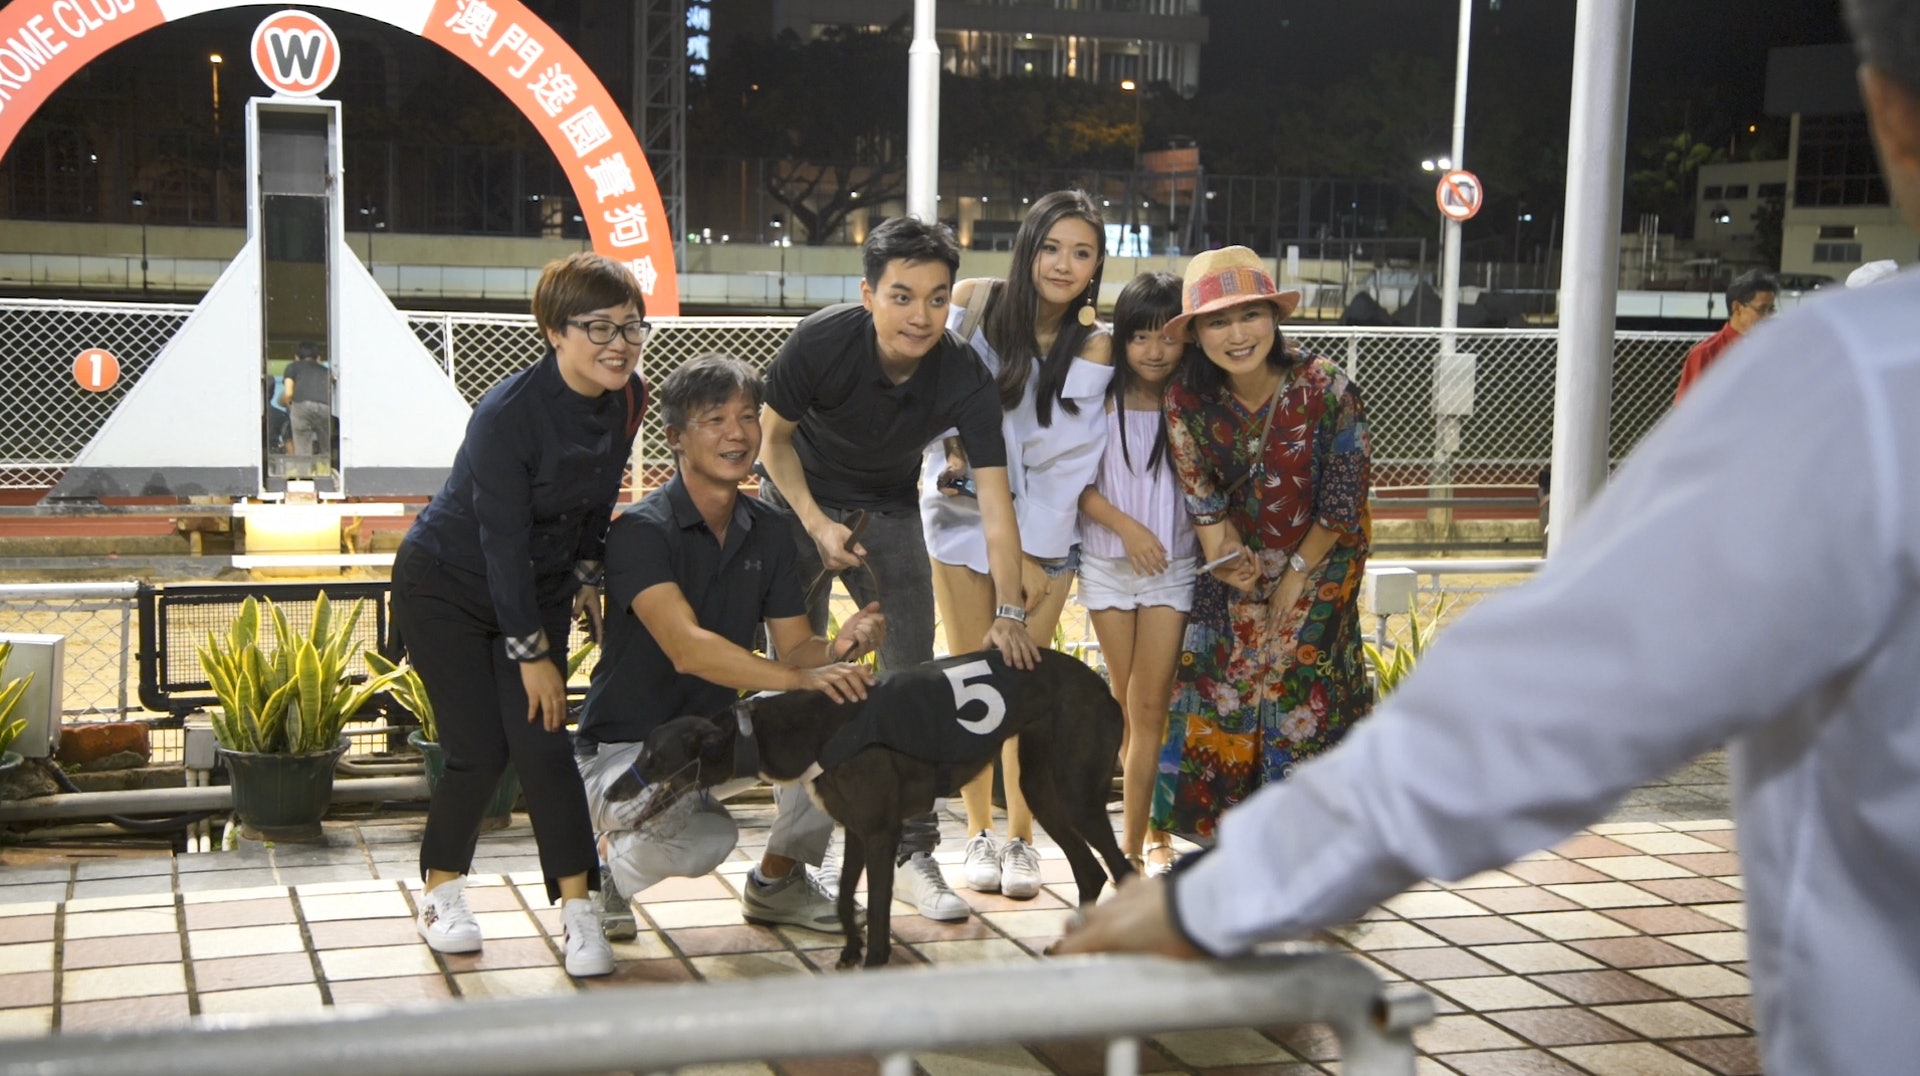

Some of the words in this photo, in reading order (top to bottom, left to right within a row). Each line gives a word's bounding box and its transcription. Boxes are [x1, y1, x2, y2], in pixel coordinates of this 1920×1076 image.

[266, 29, 325, 84] W
[89, 354, 102, 387] 1
[942, 659, 1006, 735] 5
